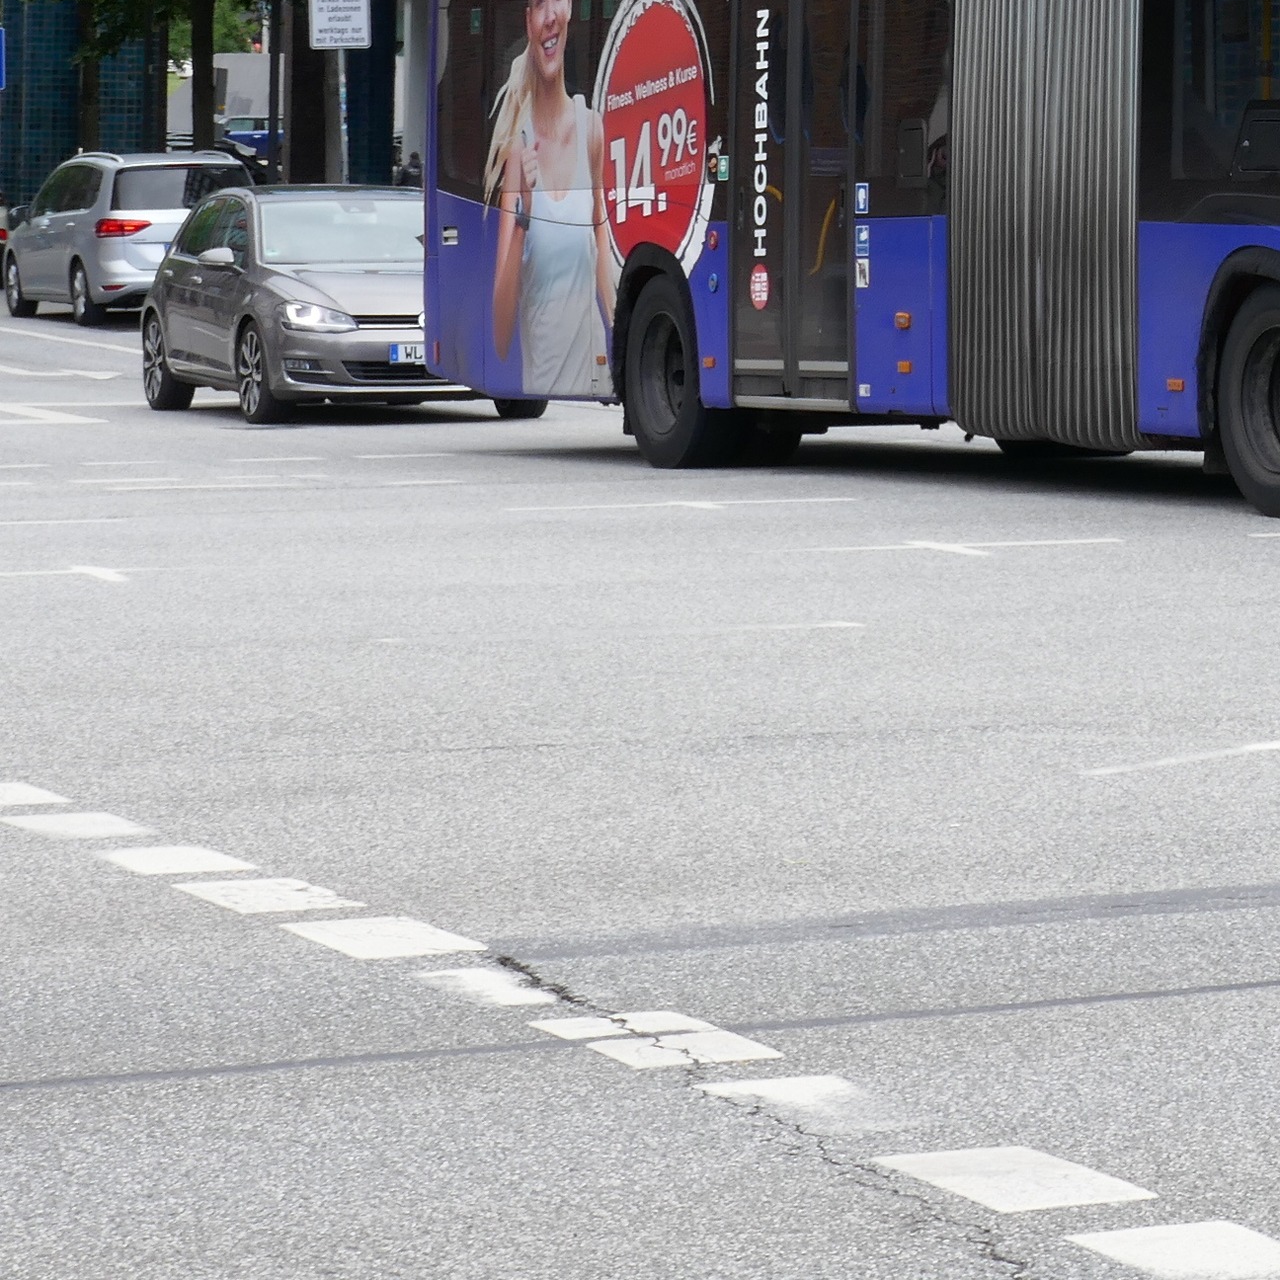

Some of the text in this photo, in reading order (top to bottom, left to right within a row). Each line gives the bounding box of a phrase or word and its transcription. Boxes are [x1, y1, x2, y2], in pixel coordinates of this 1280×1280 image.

[607, 65, 698, 112] Fitness, Wellness & Kurse
[753, 8, 770, 258] HOCHBAHN
[664, 161, 696, 182] monatlich
[404, 345, 423, 360] WL
